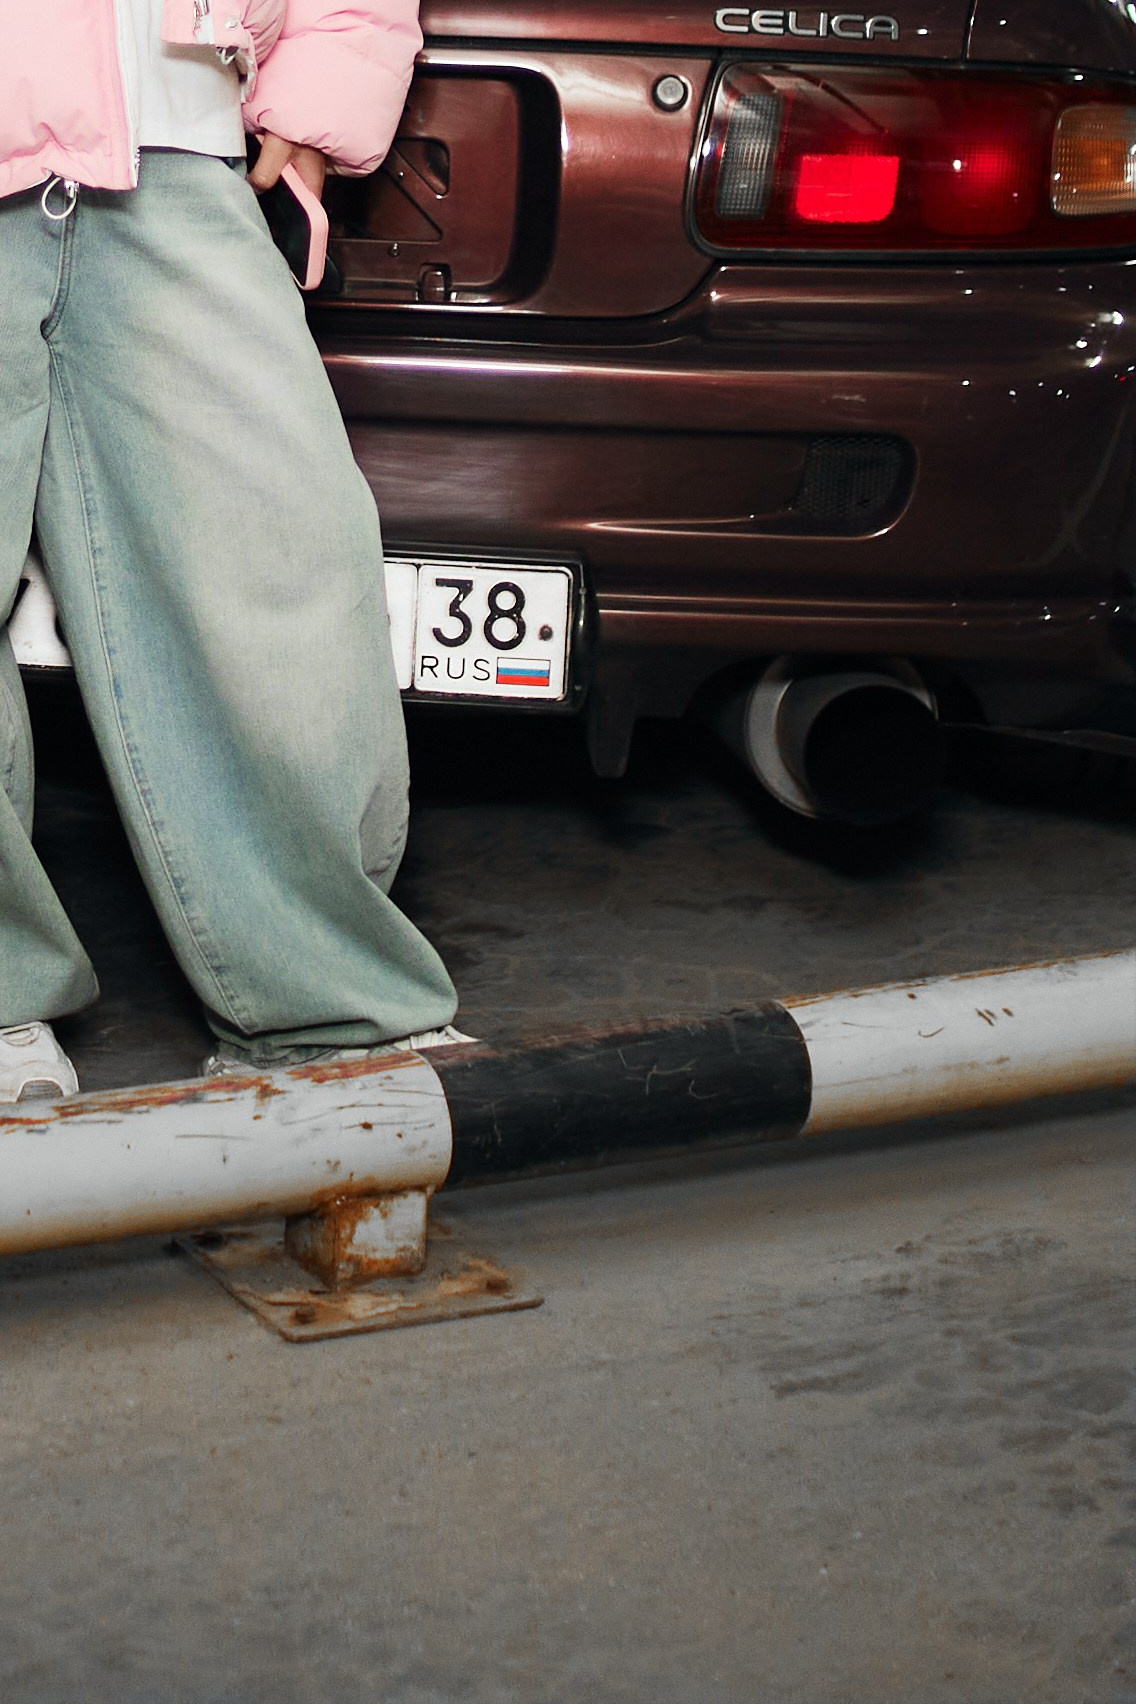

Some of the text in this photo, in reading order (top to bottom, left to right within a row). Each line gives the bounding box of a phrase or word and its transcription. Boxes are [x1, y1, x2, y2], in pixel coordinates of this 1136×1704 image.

[715, 8, 899, 41] CELICA
[432, 577, 527, 651] 38
[420, 655, 491, 681] RUS
